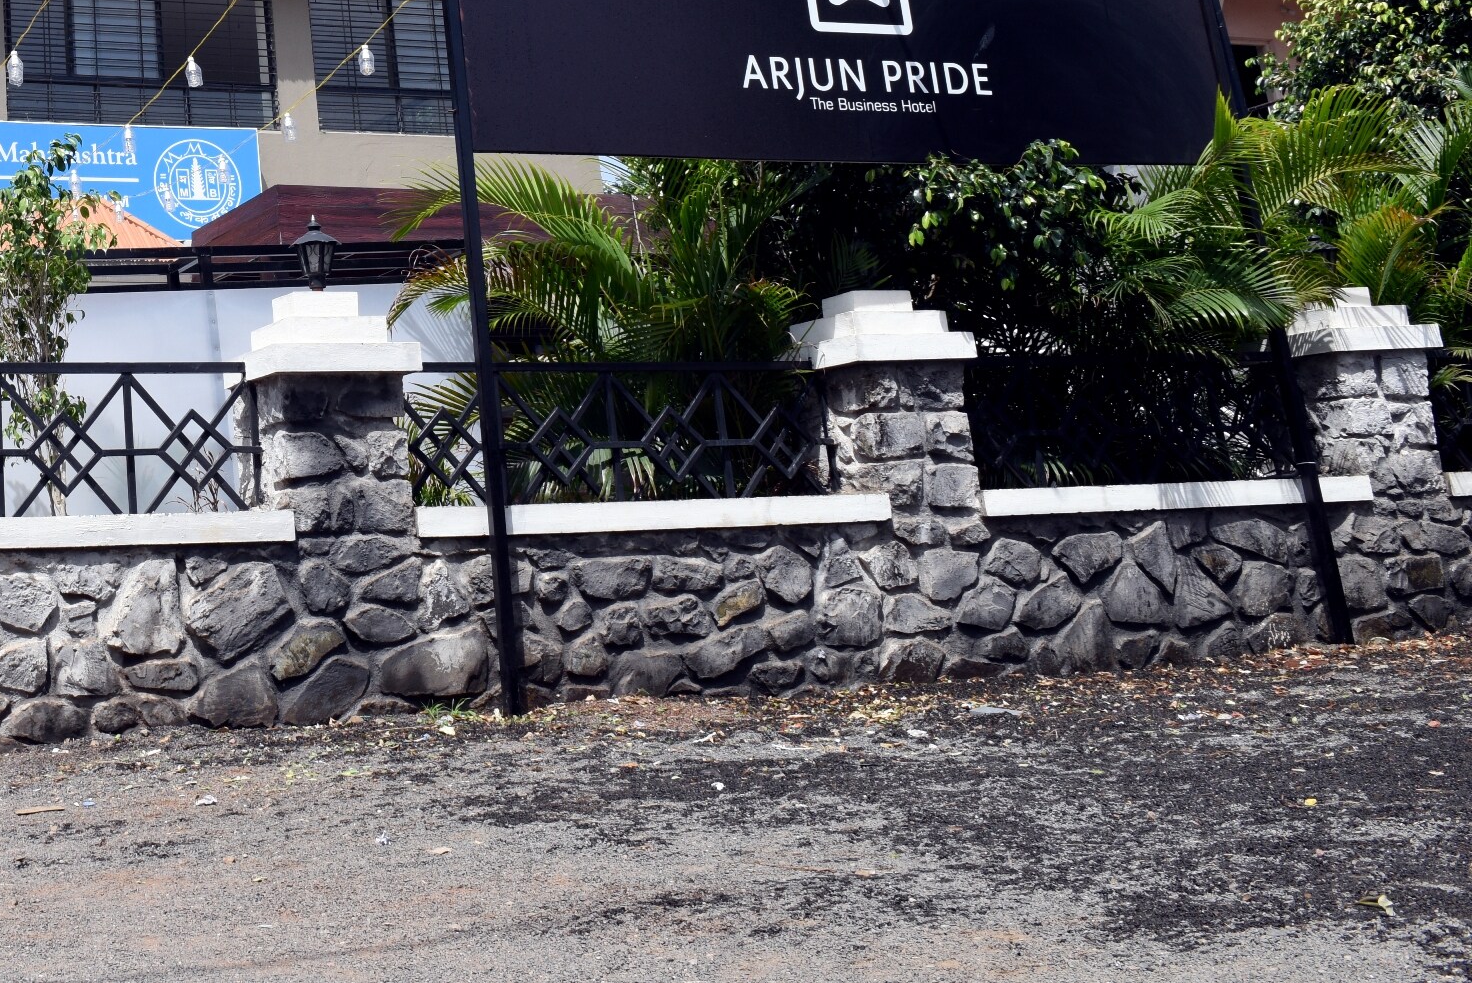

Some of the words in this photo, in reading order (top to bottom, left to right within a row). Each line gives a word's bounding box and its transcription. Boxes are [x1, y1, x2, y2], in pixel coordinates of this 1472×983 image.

[743, 55, 867, 100] ARJUN
[882, 60, 993, 95] PRIDE
[810, 97, 834, 111] The
[838, 98, 897, 112] Business
[901, 100, 936, 113] Hotel
